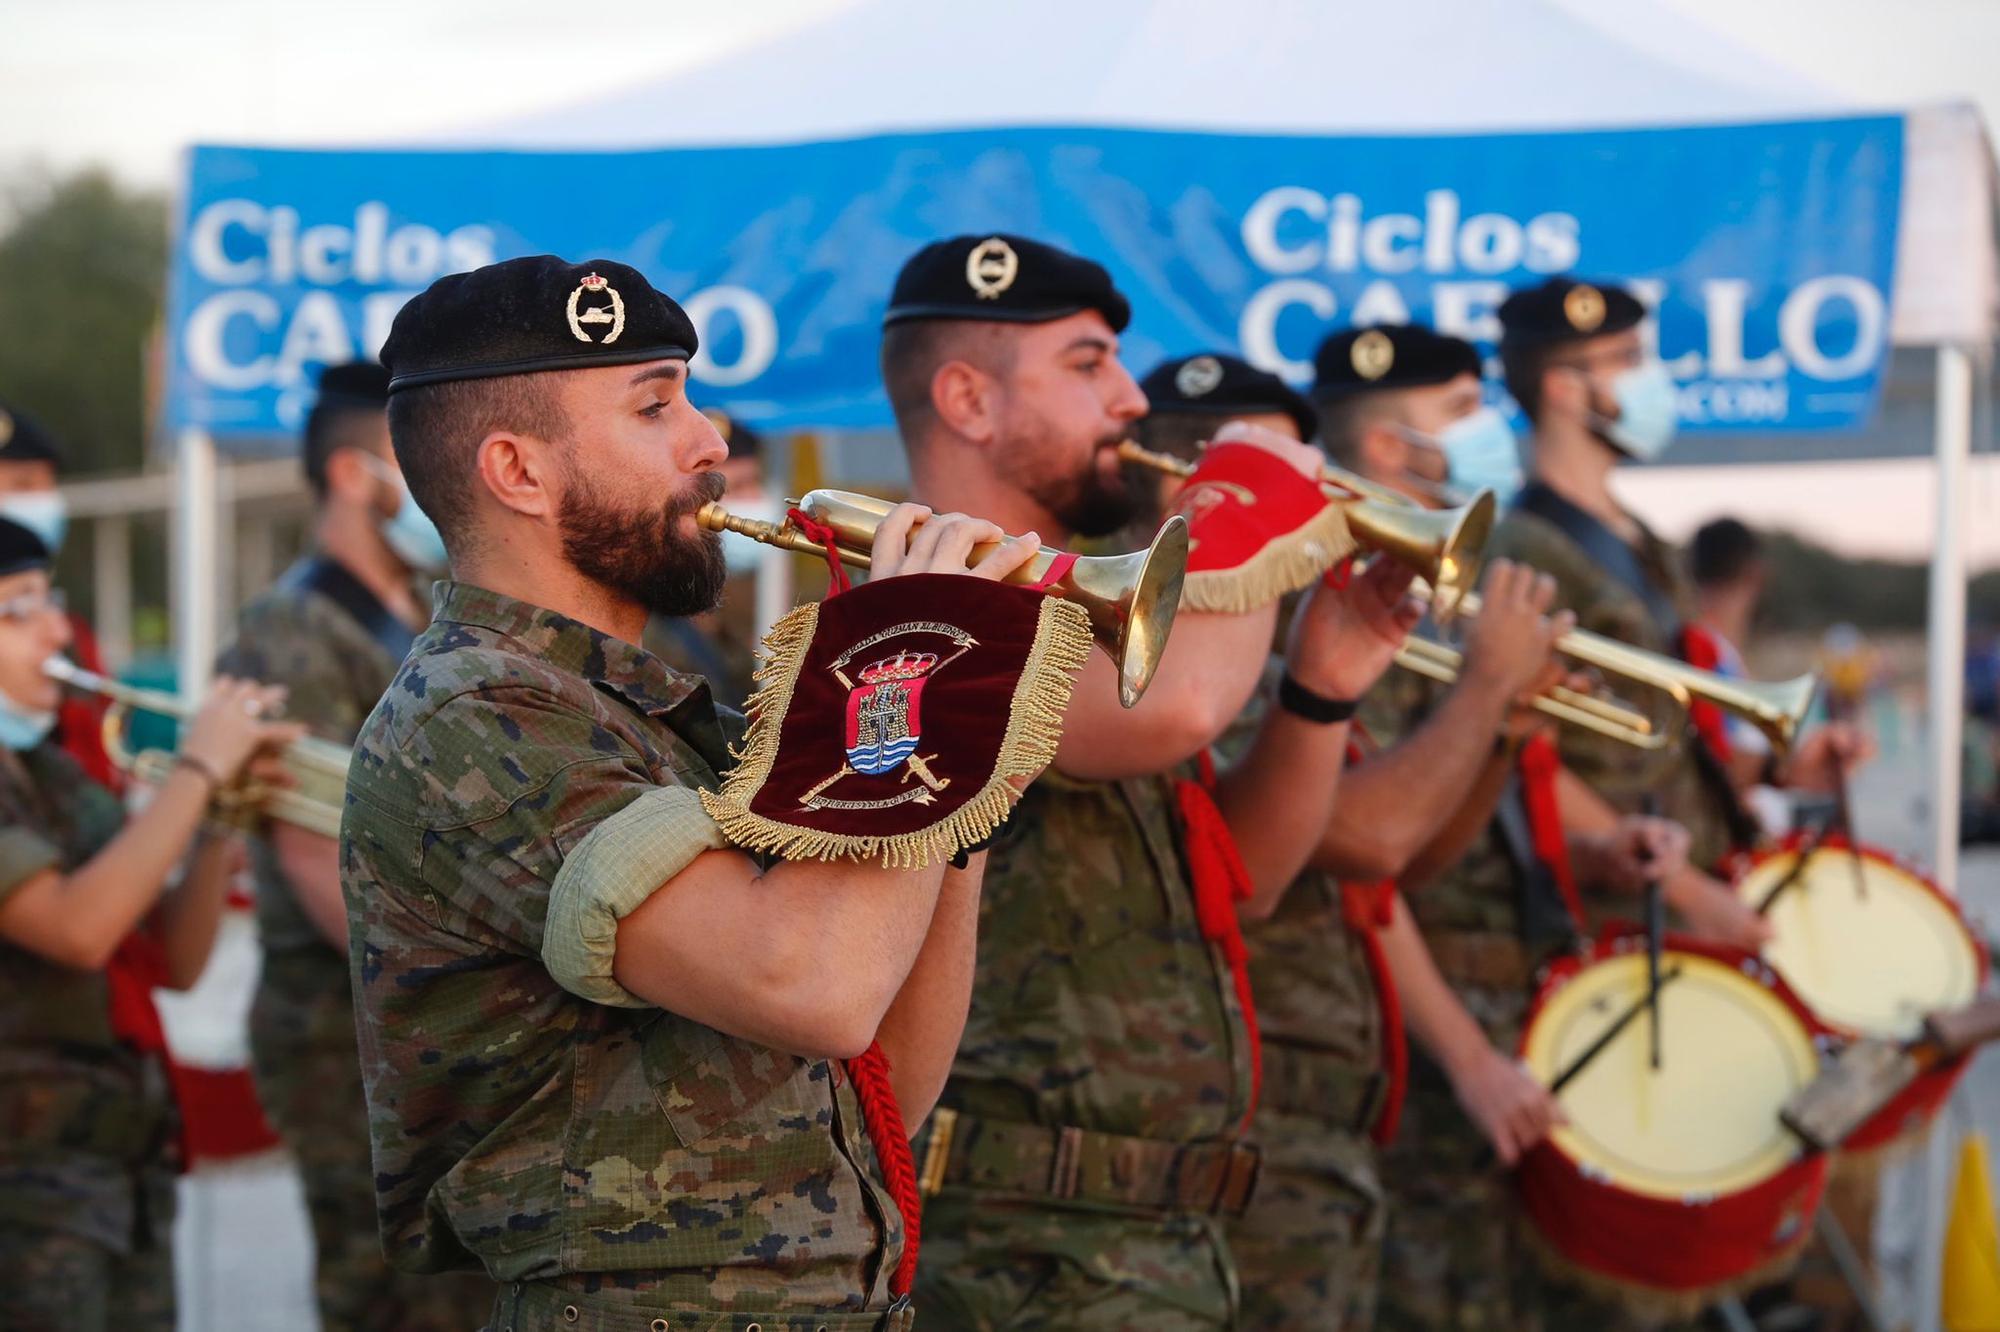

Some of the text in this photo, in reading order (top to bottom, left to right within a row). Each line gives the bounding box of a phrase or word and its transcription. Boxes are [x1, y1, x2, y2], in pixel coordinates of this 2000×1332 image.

[190, 199, 497, 284] Ciclos
[1241, 186, 1580, 274] Ciclos
[1238, 275, 1887, 384] CABLLO
